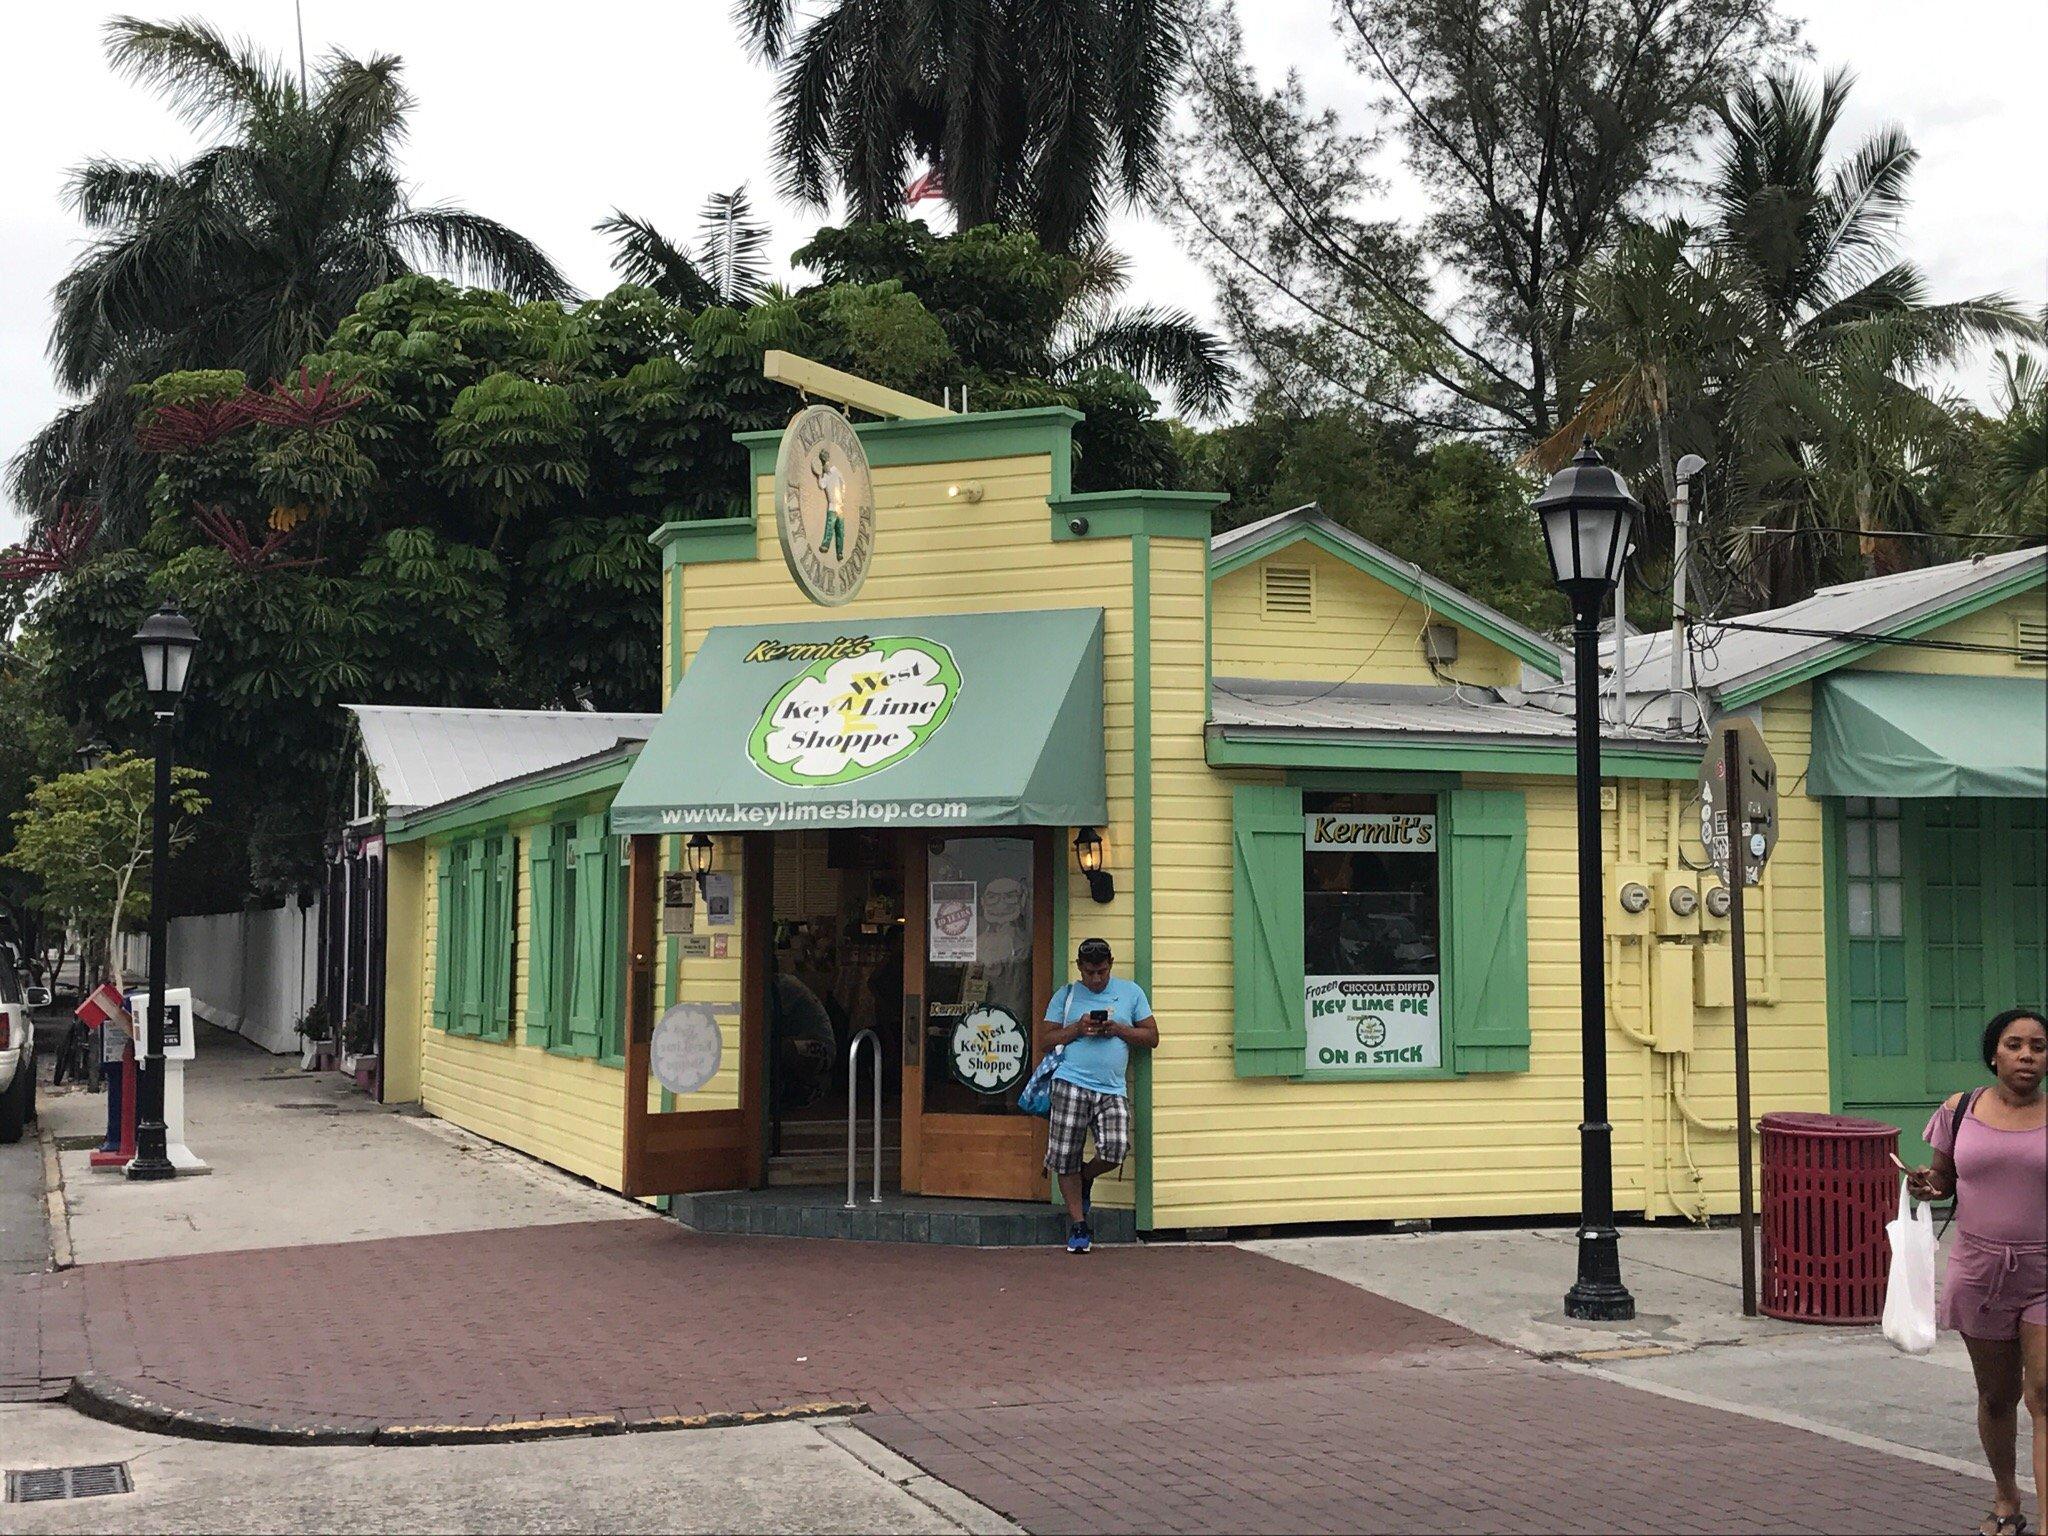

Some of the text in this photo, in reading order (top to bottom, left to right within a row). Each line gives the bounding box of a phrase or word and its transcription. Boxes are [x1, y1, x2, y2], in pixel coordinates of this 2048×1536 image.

[787, 481, 807, 543] KEY
[838, 505, 872, 596] SHOPPE
[743, 636, 875, 663] Kermit's
[850, 661, 922, 696] West
[782, 697, 937, 724] Key Lime
[787, 729, 900, 754] Shoppe
[660, 798, 968, 827] www.keylimeshop.com
[1314, 816, 1433, 844] Kermit's
[1305, 980, 1430, 999] Frozen CHOCOLATE DIPPED
[1312, 999, 1347, 1018] KEY
[1352, 999, 1394, 1011] LIME
[1400, 999, 1428, 1016] PIE
[976, 1024, 1006, 1042] West
[961, 1040, 1019, 1055] Key Lime
[1319, 1045, 1423, 1064] ON A STICK
[968, 1057, 1012, 1073] Shoppe
